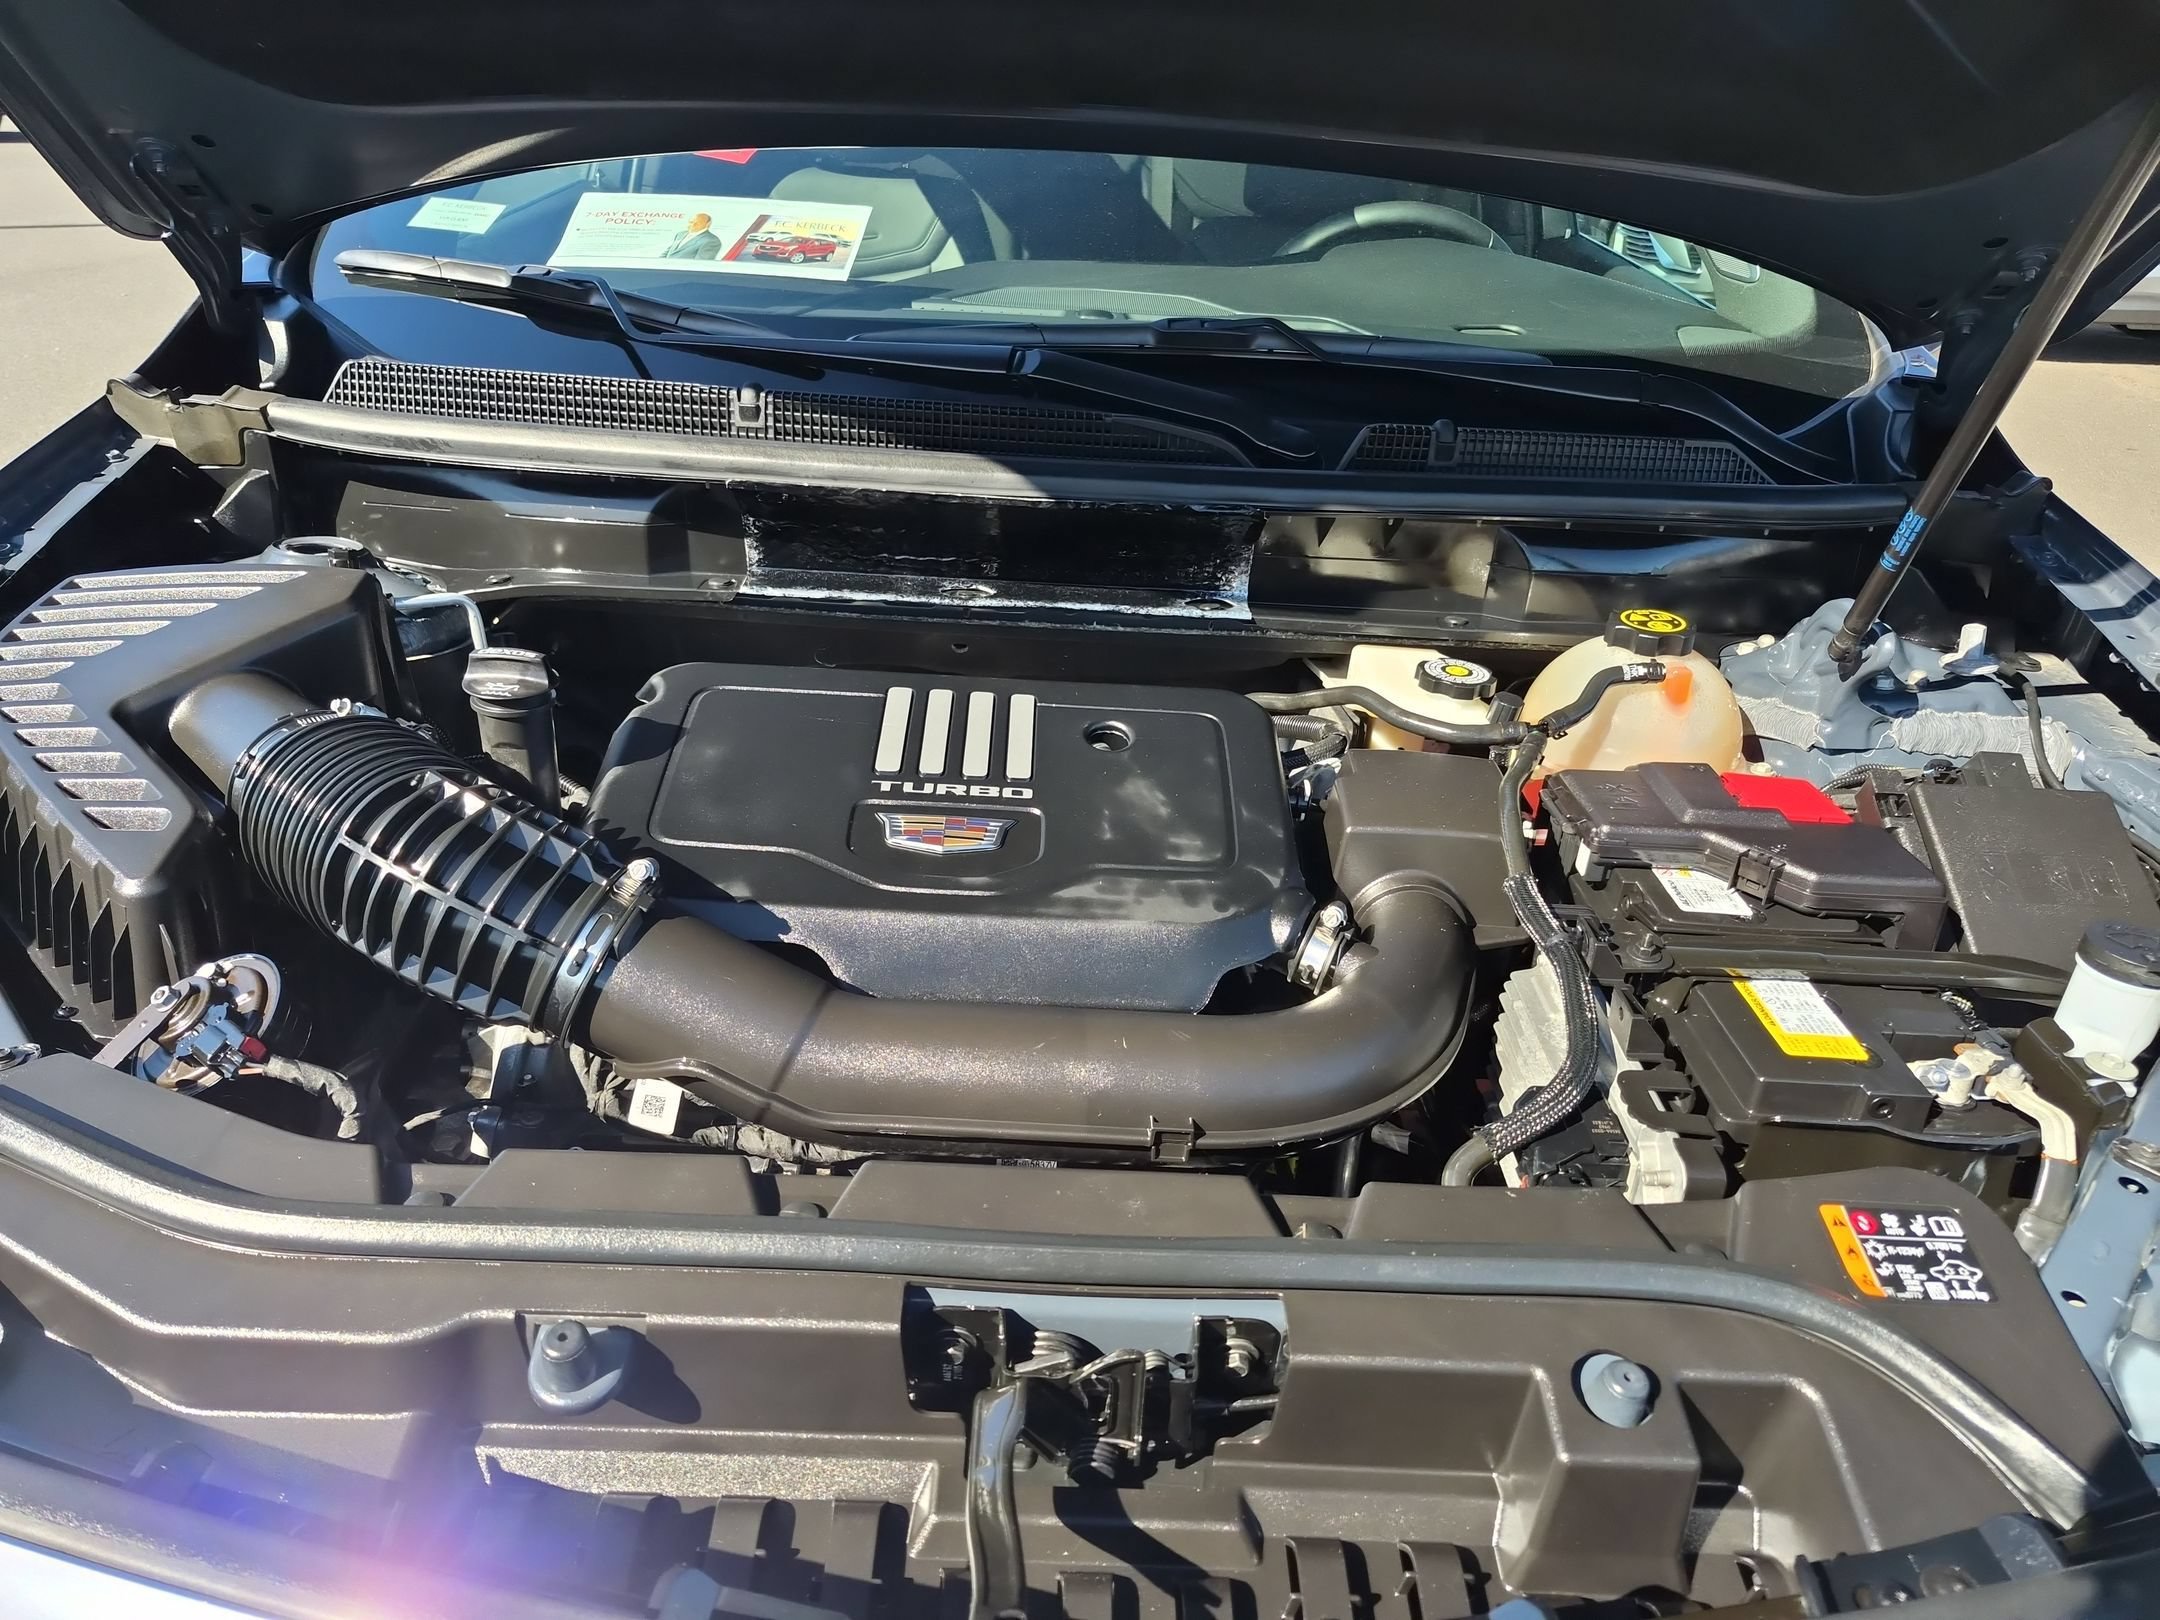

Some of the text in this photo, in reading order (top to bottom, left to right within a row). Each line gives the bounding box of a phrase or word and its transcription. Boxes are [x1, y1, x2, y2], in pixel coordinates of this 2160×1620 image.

[586, 211, 685, 219] 7-DAY EXCHANGE
[795, 221, 846, 233] KERBECK
[871, 780, 1033, 799] TURBO
